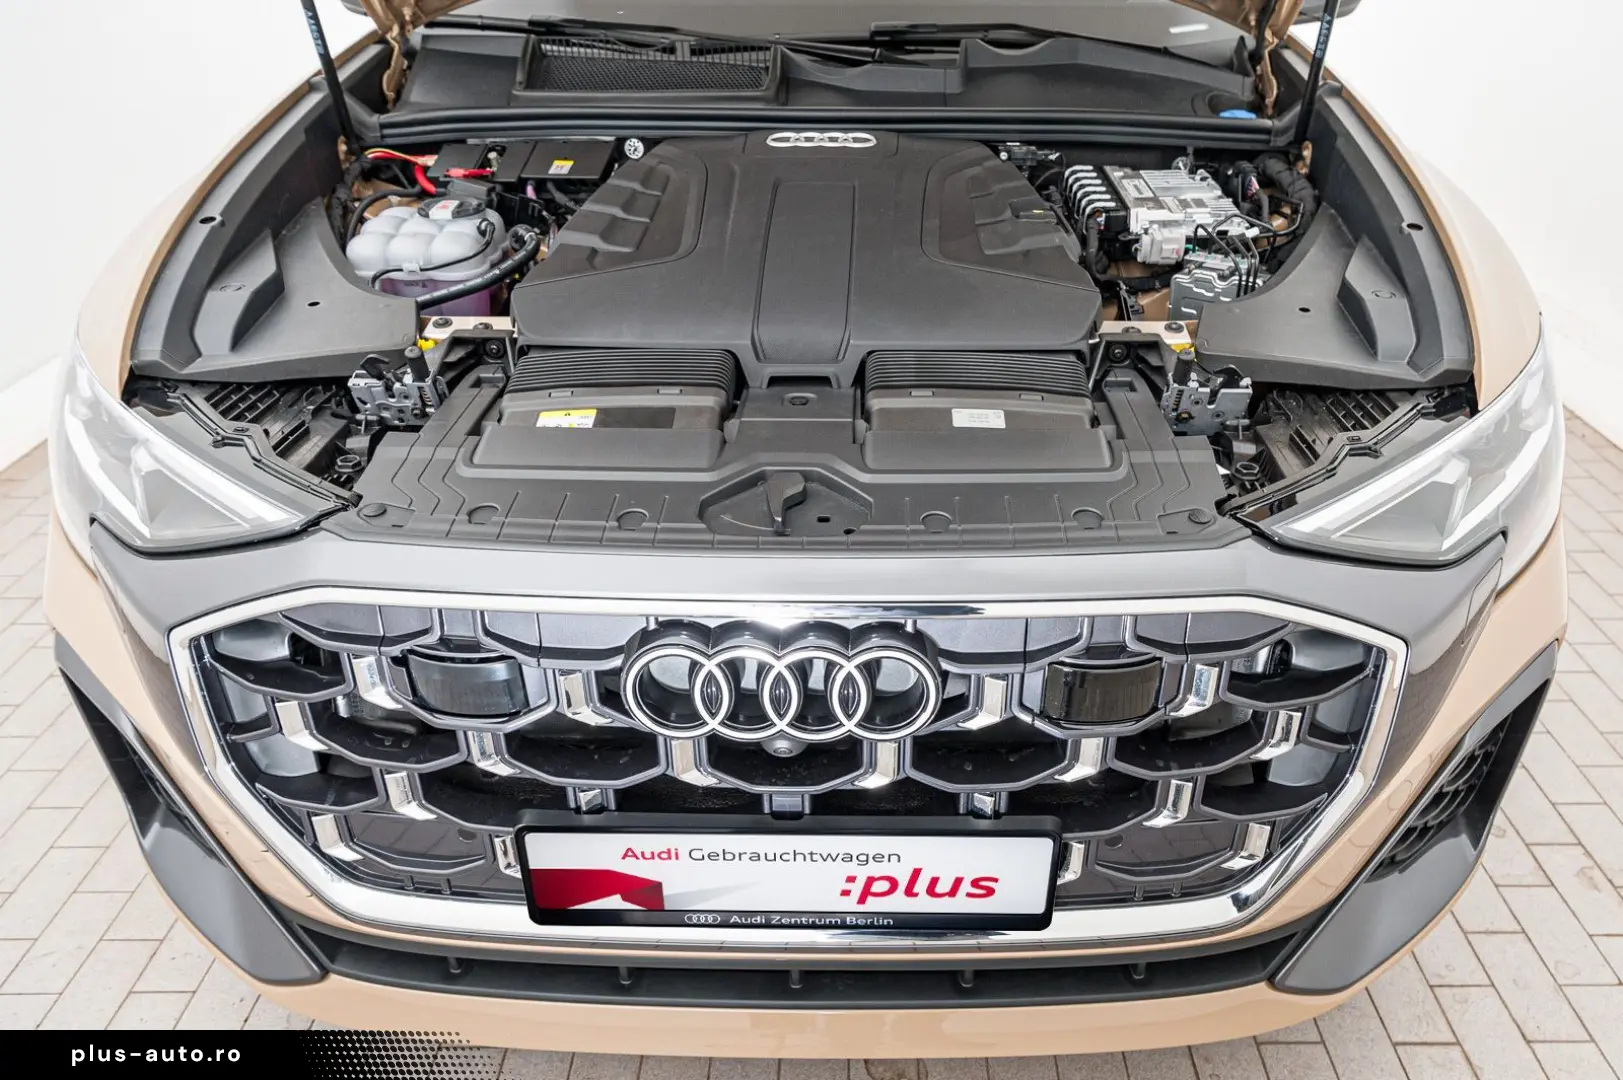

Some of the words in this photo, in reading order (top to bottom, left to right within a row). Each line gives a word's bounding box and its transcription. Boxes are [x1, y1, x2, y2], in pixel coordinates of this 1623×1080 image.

[620, 847, 680, 861] Audi
[688, 848, 902, 867] Gebrauchtwagen
[839, 867, 1000, 906] :plus
[729, 914, 765, 925] Audi
[770, 914, 841, 926] Zentrum
[846, 915, 894, 927] Berlin
